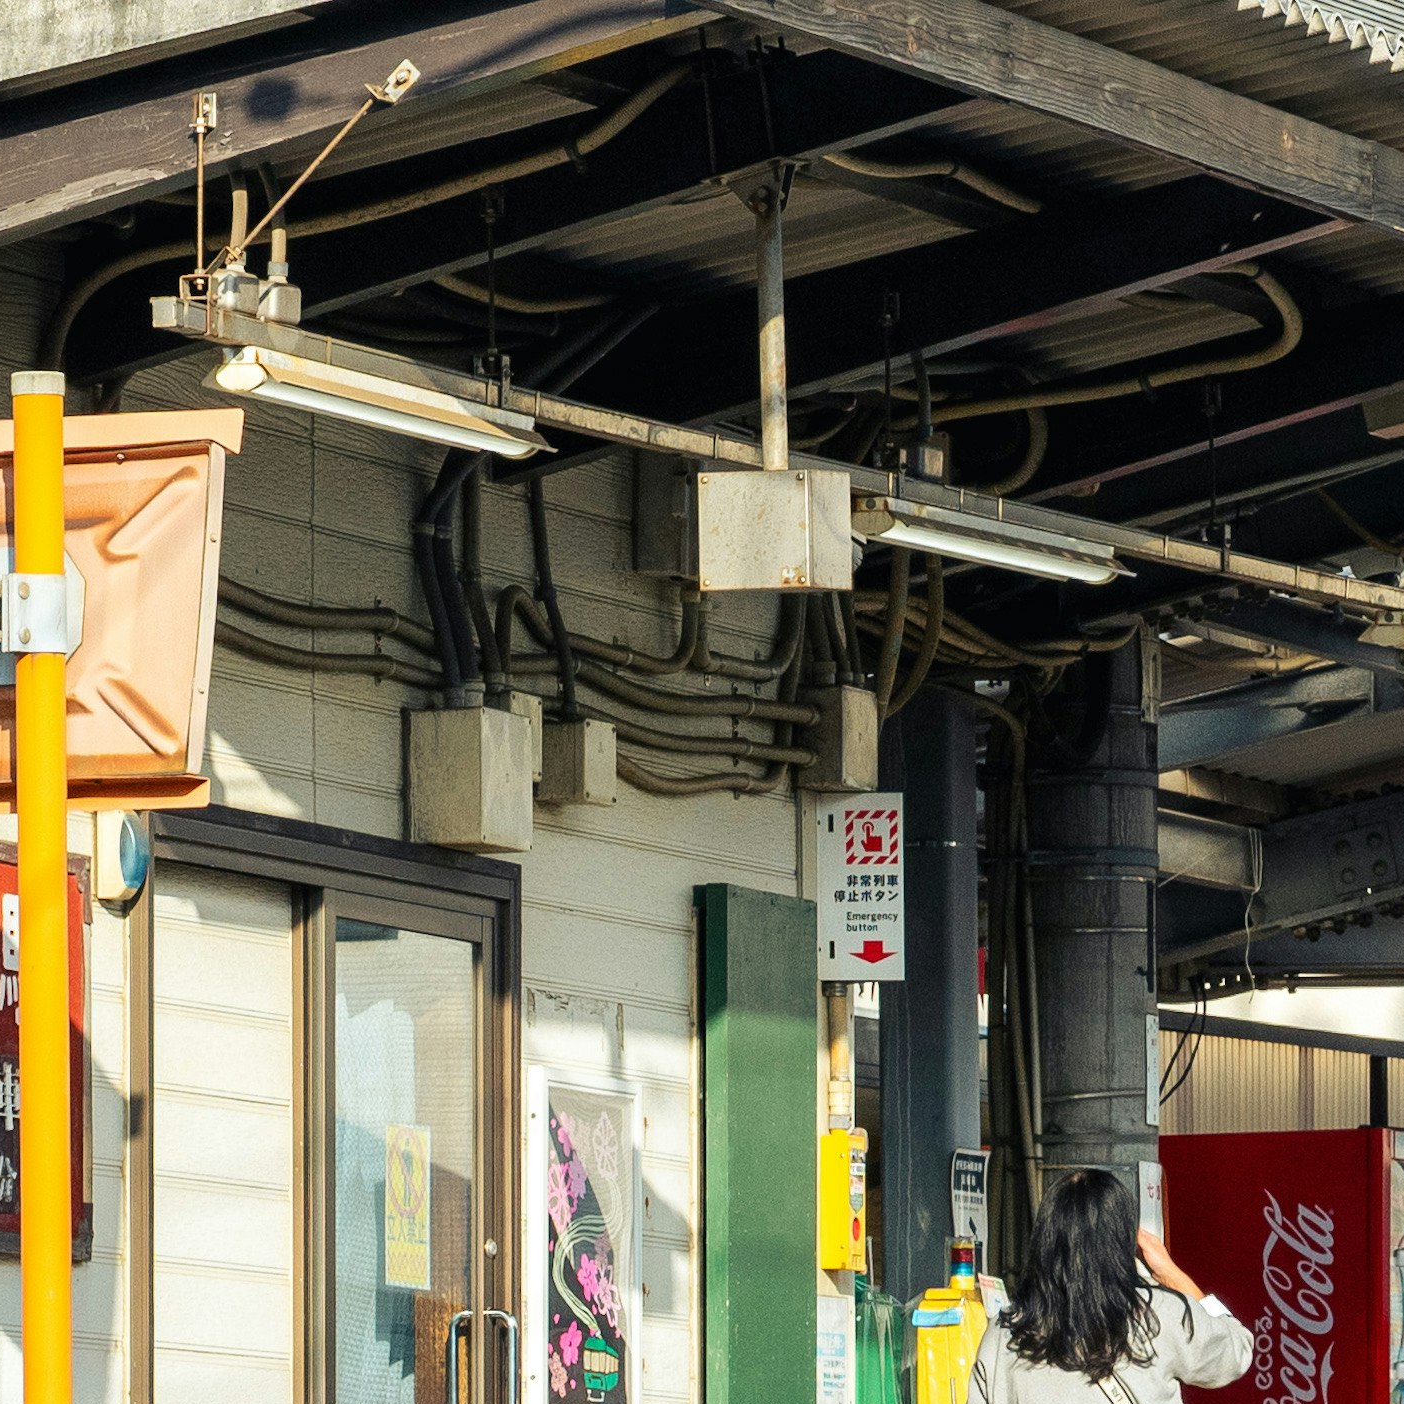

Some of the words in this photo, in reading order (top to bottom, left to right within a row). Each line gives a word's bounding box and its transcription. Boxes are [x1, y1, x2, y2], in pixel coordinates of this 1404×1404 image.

[846, 874, 899, 887] 非常列車
[834, 890, 899, 902] 停止ボタン
[846, 911, 899, 922] Emergency
[846, 923, 879, 932] button
